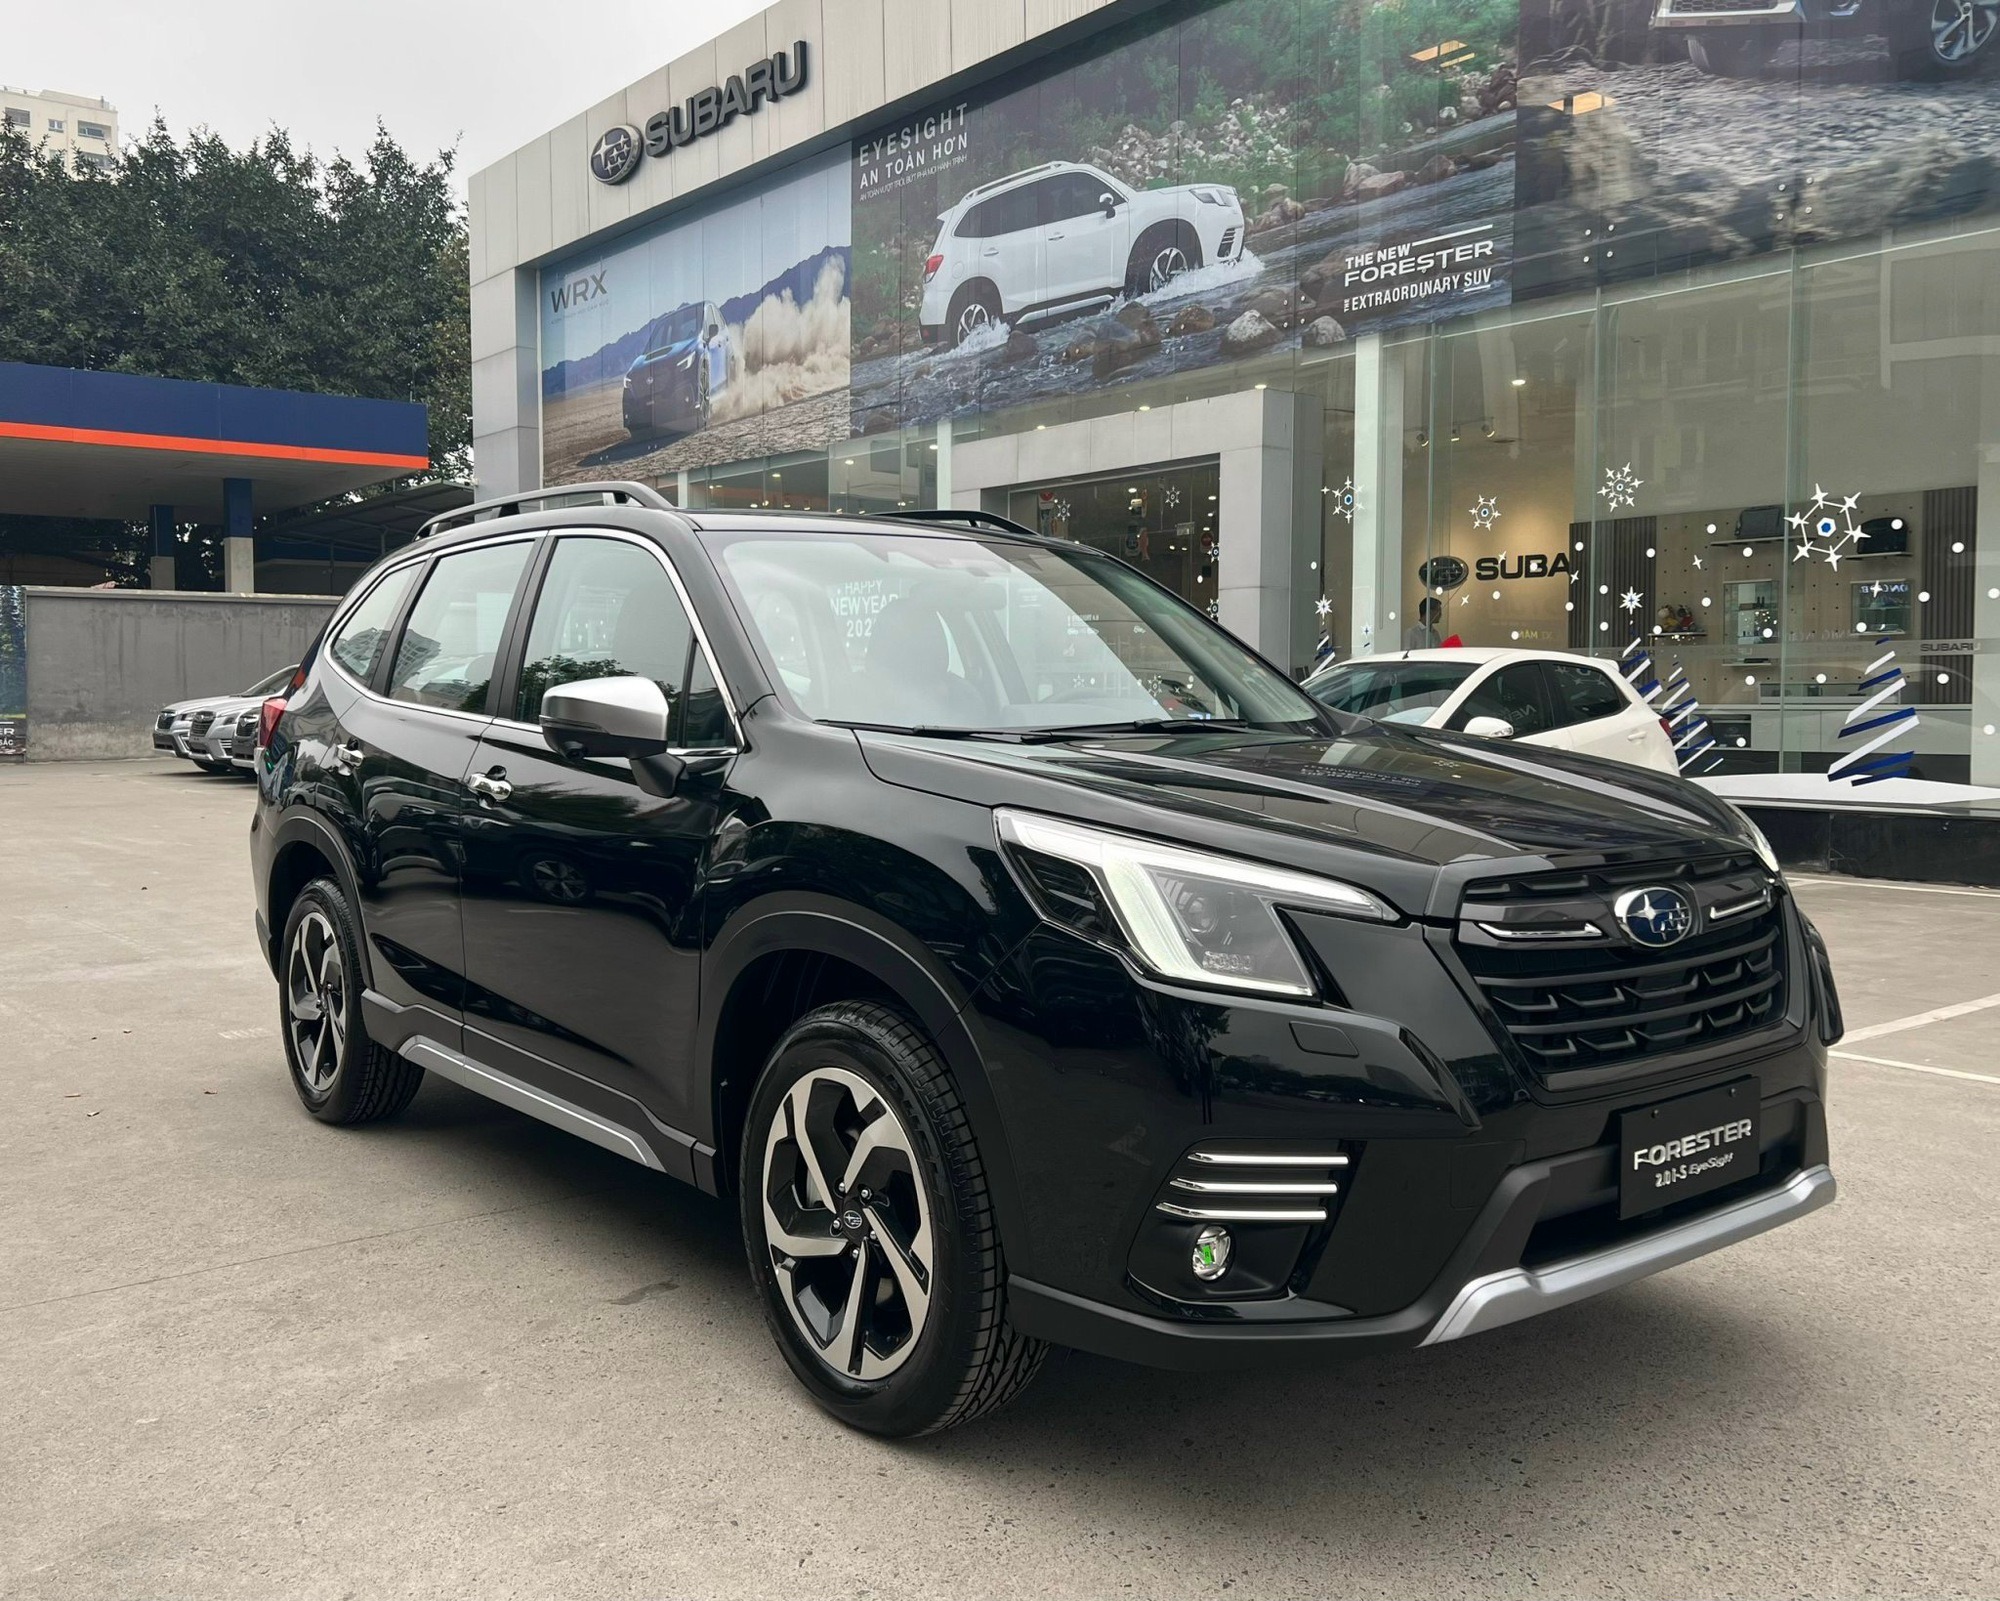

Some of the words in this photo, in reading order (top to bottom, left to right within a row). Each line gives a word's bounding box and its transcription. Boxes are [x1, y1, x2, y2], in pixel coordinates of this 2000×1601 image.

[645, 40, 808, 158] SUBARU
[859, 102, 968, 167] EYESIGHT
[860, 168, 879, 190] AN
[885, 150, 925, 179] TOÀN
[933, 132, 967, 161] HƠN
[1344, 240, 1494, 287] FORESTER
[1345, 252, 1374, 270] THE
[1377, 243, 1411, 263] NEW
[551, 270, 607, 313] WRX
[1352, 273, 1460, 311] EXTRAORDINARY
[1463, 267, 1492, 287] SUV
[830, 596, 861, 616] NEW
[845, 580, 883, 595] HAPPY
[846, 617, 876, 637] 202
[1920, 642, 1981, 651] SUBARU
[1633, 1118, 1752, 1171] FORESTER
